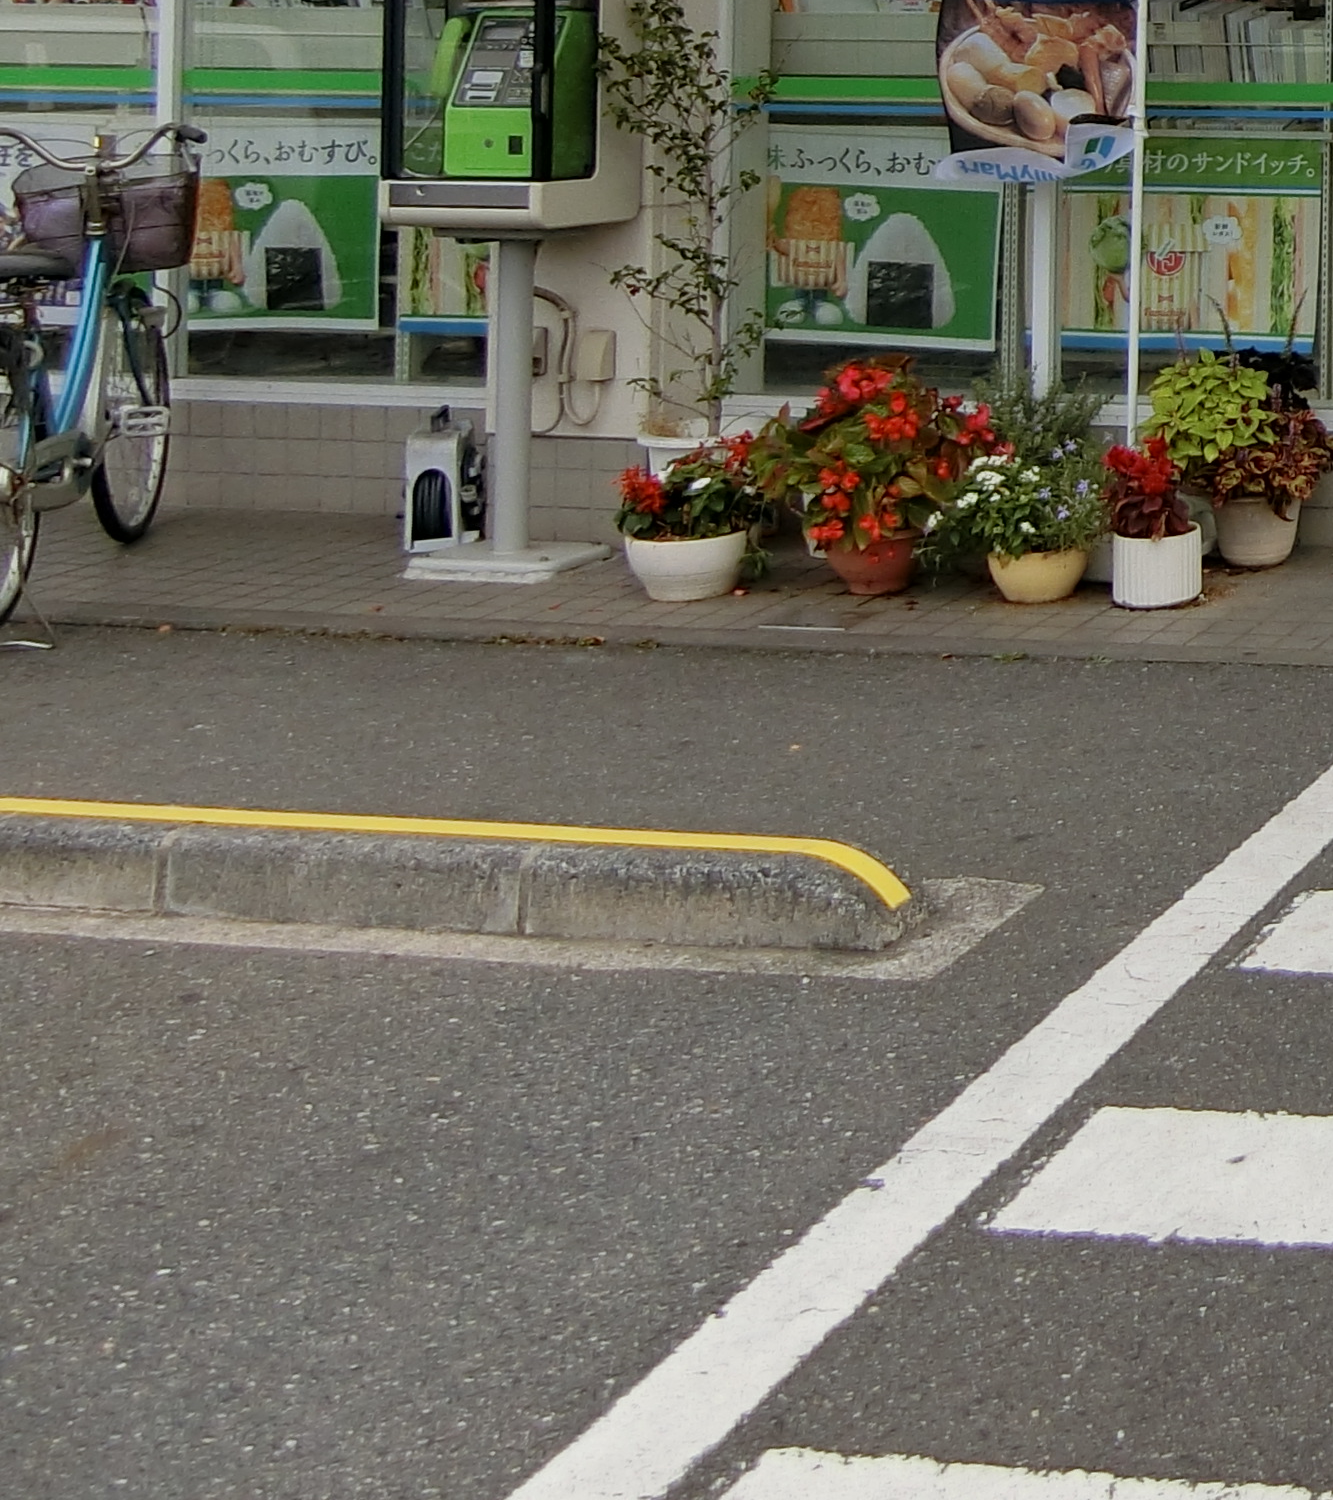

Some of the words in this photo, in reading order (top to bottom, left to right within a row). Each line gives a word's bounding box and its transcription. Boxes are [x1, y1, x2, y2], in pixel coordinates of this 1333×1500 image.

[768, 144, 946, 177] 味ふっくら、おむ
